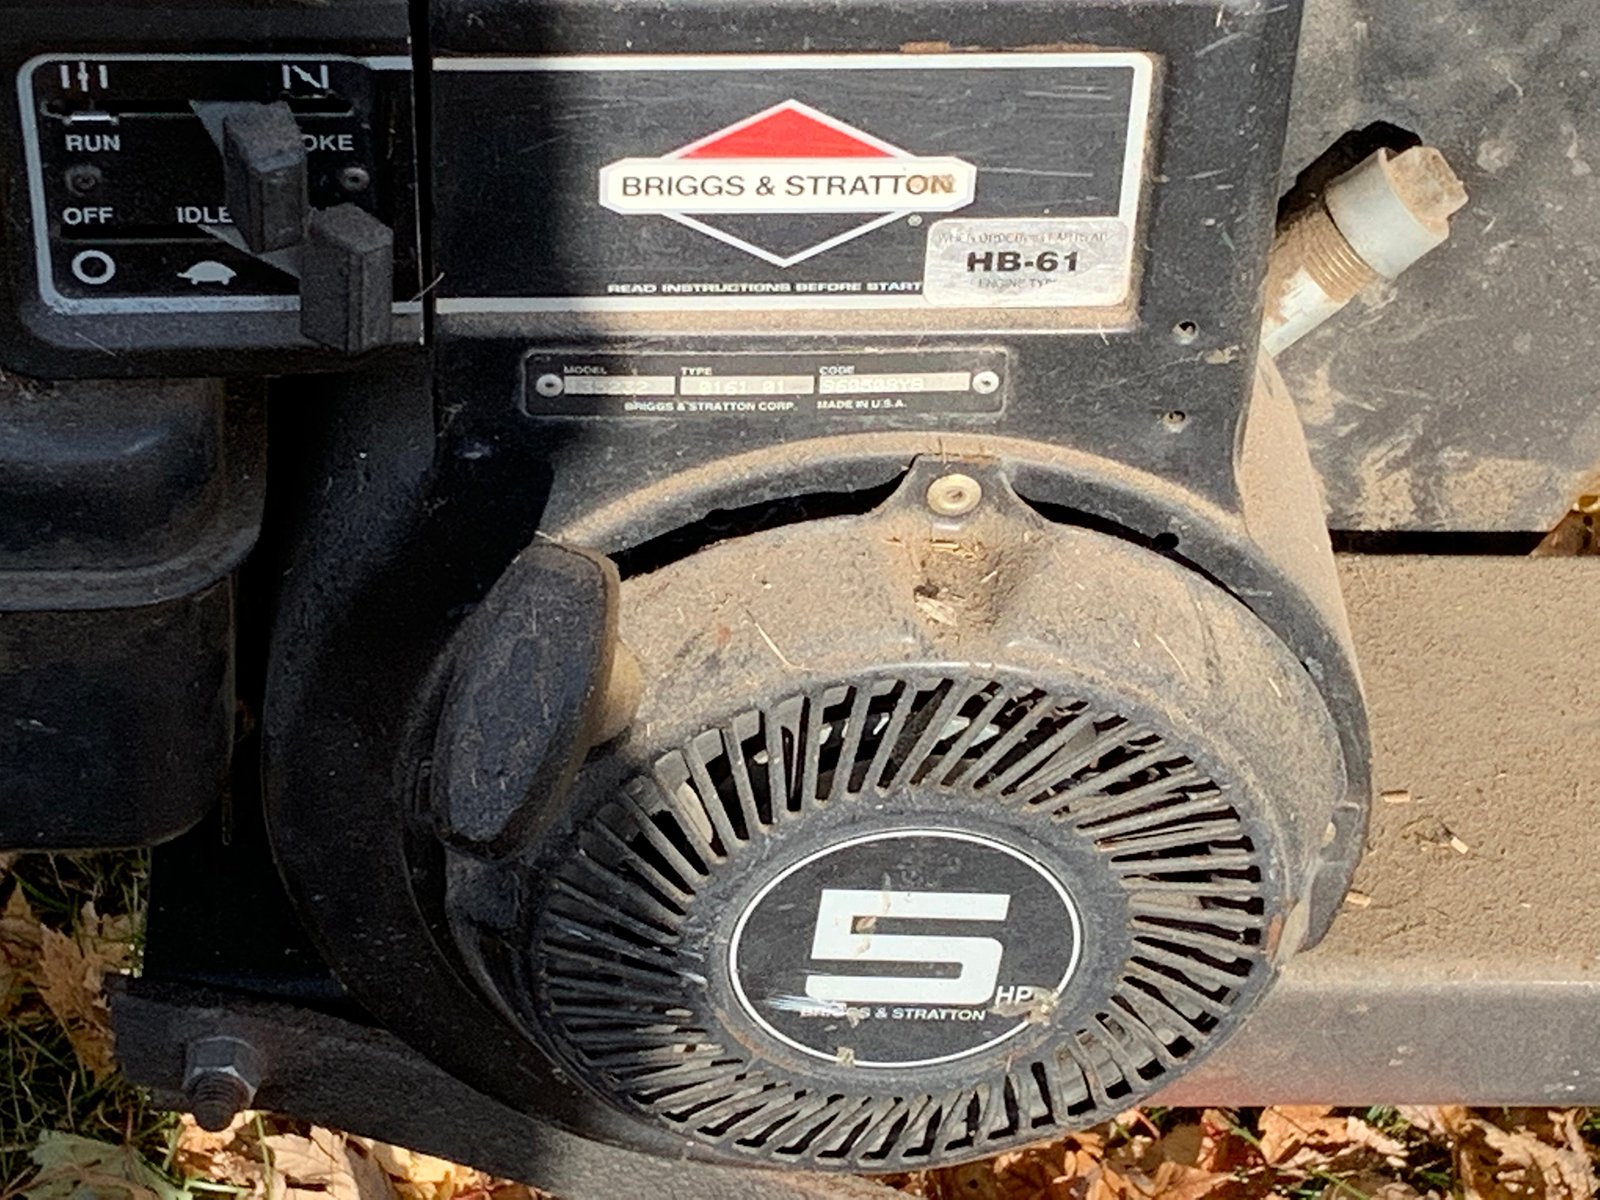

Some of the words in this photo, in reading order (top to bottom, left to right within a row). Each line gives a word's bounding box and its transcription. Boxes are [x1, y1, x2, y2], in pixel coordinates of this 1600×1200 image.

[65, 134, 120, 151] RUN
[301, 134, 354, 151] OKE
[621, 175, 745, 197] BRIGGS
[755, 175, 776, 197] &
[785, 174, 957, 197] STRATTON
[62, 206, 114, 224] OFF
[176, 206, 233, 223] IDLE
[967, 251, 1079, 272] HB-61
[607, 282, 657, 294] READ
[662, 282, 791, 293] INSTRUCTIONS
[796, 281, 861, 293] BEFORE
[866, 281, 922, 292] START
[564, 365, 607, 375] MODEL
[681, 366, 712, 376] TYPE
[819, 365, 855, 375] CODE
[624, 401, 674, 411] BRIGGS
[676, 401, 686, 411] &
[687, 401, 755, 411] STRATTON
[759, 401, 798, 411] CORP.
[817, 400, 853, 409] MADE
[856, 400, 869, 409] IN
[872, 399, 907, 409] U.S.A.
[805, 889, 1011, 1005] 5
[996, 984, 1032, 1007] HP
[875, 1006, 888, 1019] &
[892, 1007, 986, 1021] STRATTON
